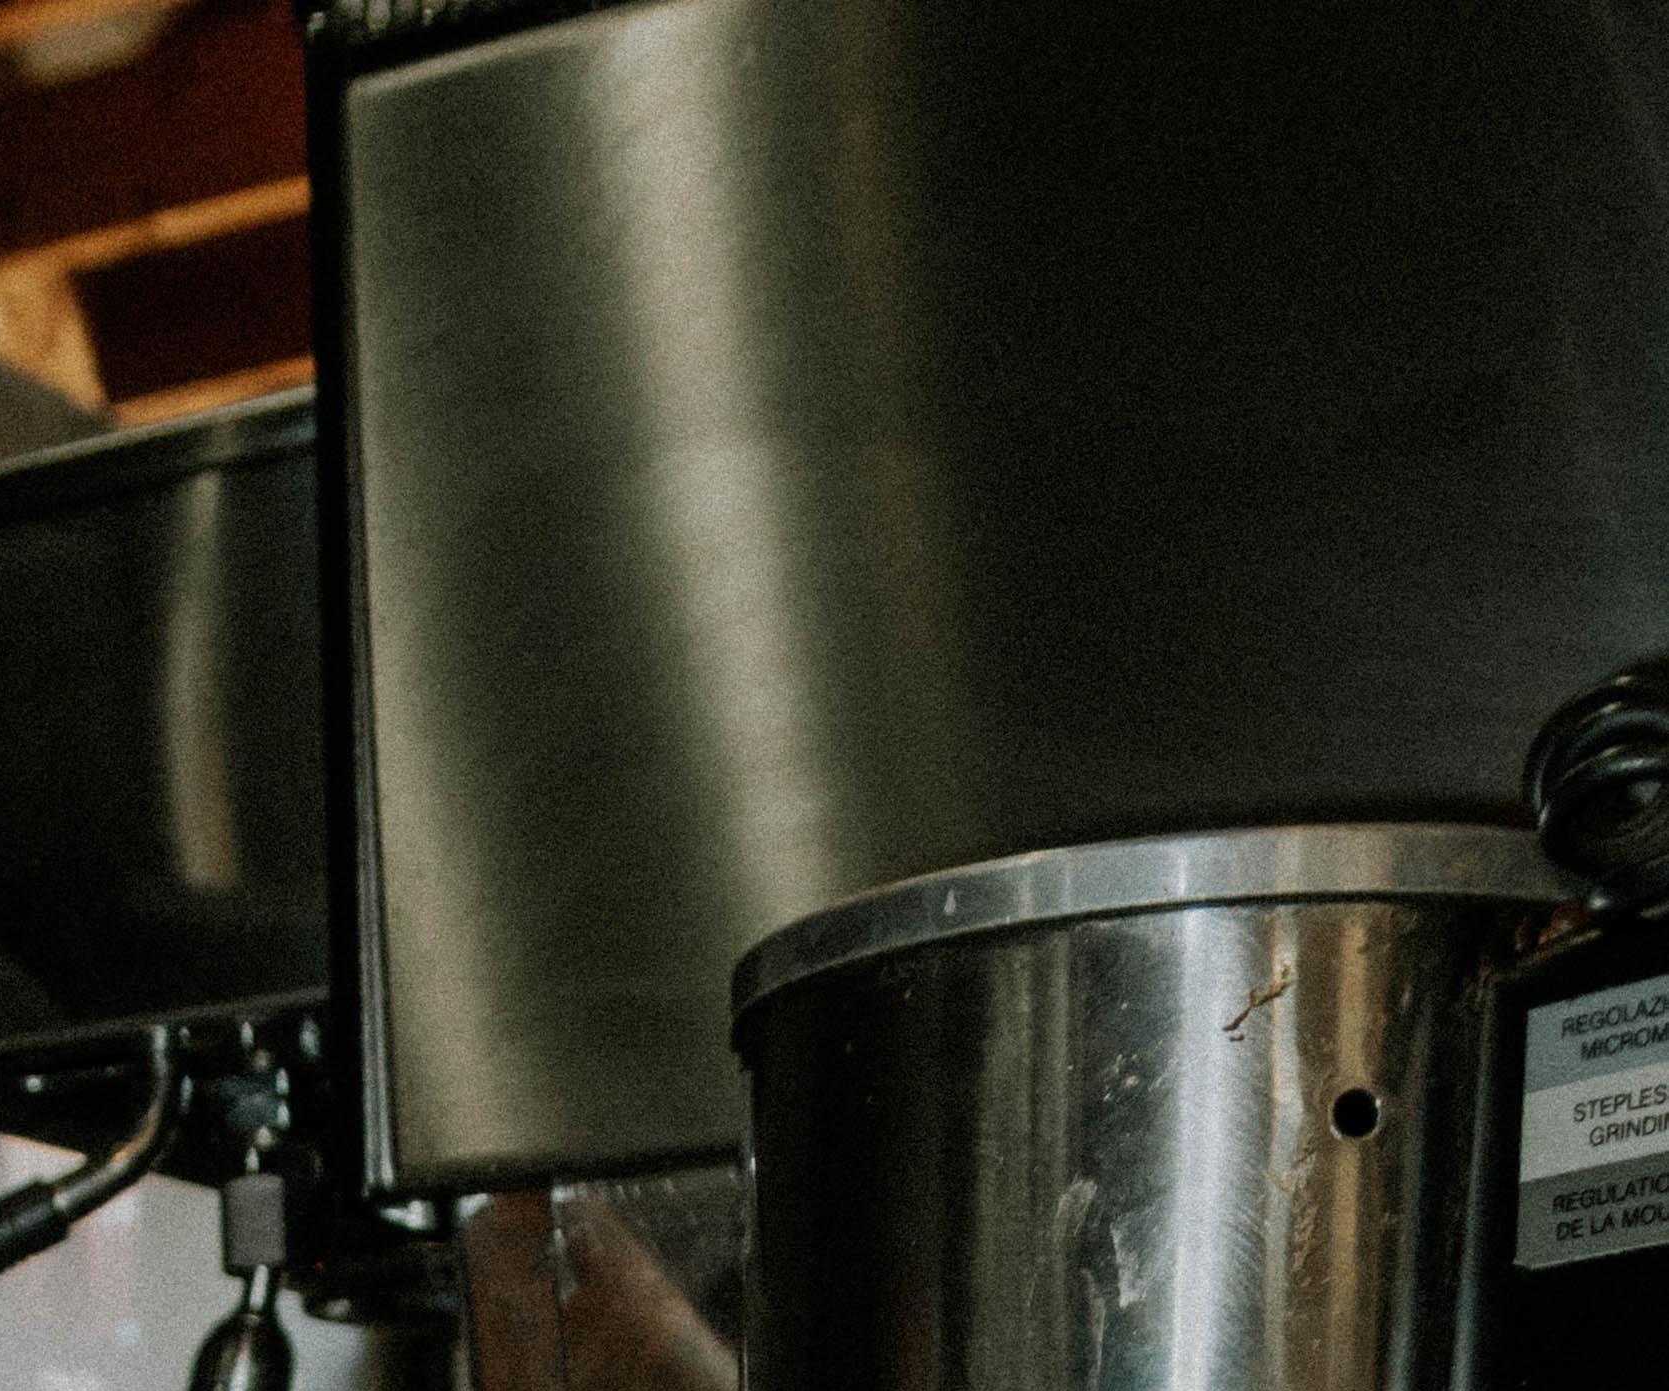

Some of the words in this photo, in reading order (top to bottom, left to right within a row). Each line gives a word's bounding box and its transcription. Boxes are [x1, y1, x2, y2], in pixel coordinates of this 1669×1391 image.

[1573, 1084, 1668, 1123] STEPLES
[1556, 1218, 1583, 1242] DE
[1590, 1212, 1615, 1236] LA
